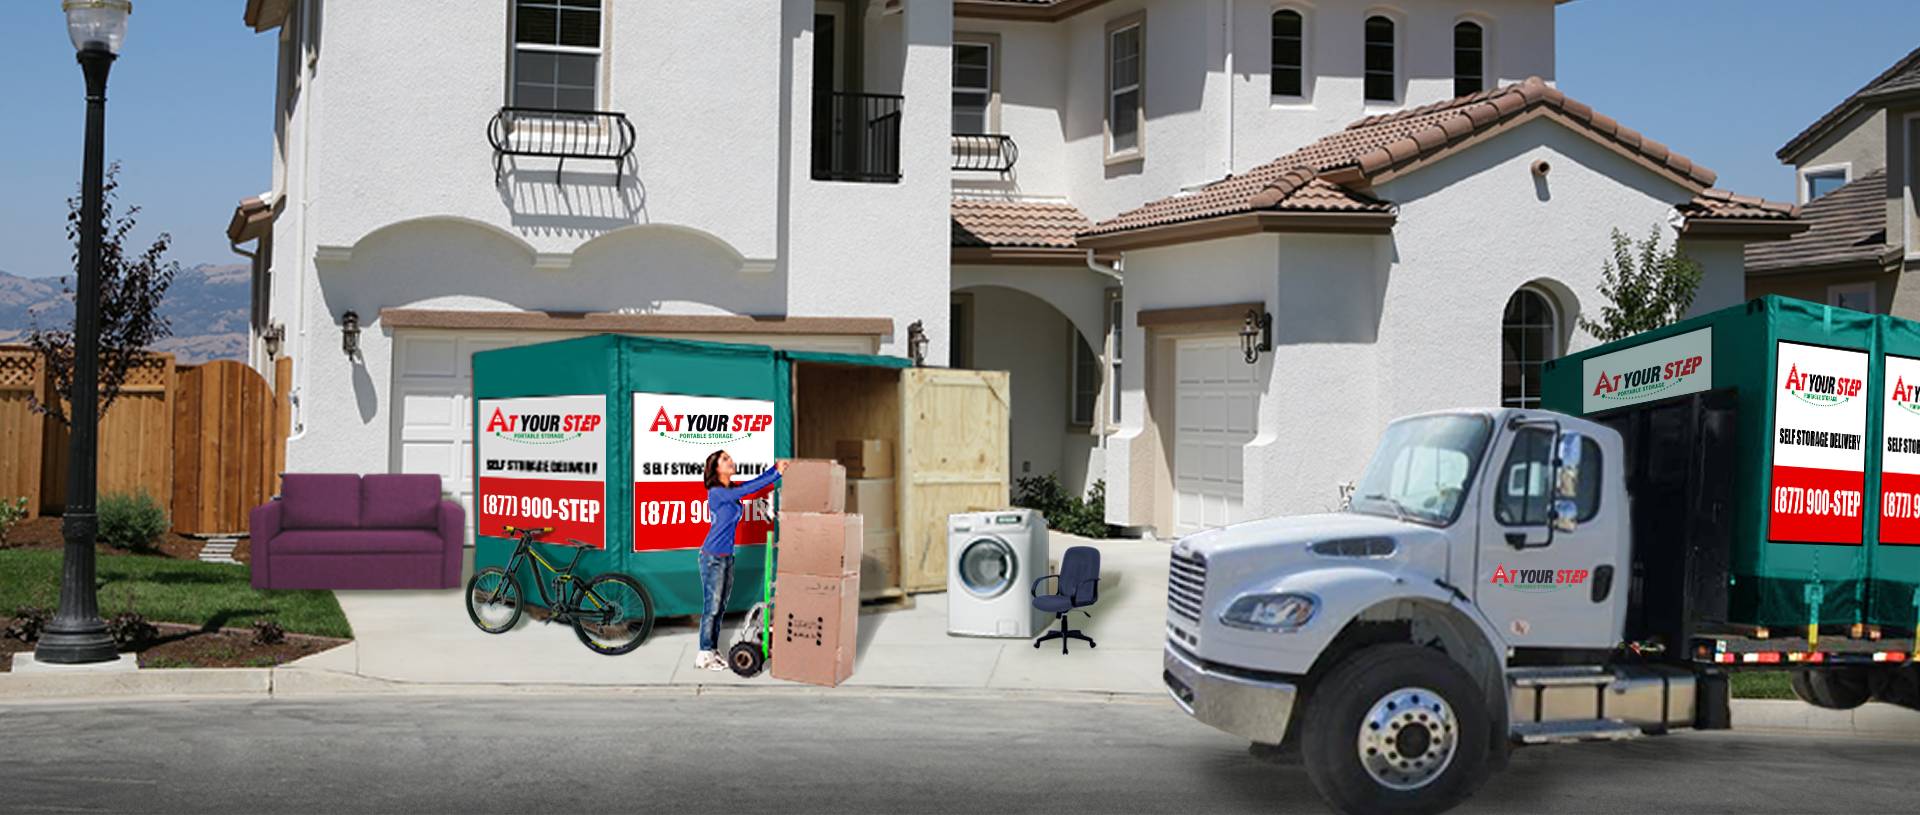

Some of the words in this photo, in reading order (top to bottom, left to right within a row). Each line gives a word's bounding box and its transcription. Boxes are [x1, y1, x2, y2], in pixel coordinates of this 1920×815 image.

[1593, 371, 1622, 396] AT
[1624, 365, 1662, 389] YOUR
[1664, 356, 1702, 380] STEP
[1785, 363, 1808, 391] AT
[1809, 374, 1836, 396] YOUR
[1837, 377, 1862, 397] STEP
[486, 406, 518, 432] AT
[521, 415, 560, 432] YOUR
[563, 414, 601, 432] STEP
[649, 405, 684, 432] AT
[687, 415, 729, 431] YOUR
[732, 414, 773, 432] STEP
[1779, 428, 1796, 445] SELF
[1797, 430, 1829, 448] STORAGE
[1830, 433, 1861, 451] DELIVERY
[1887, 437, 1903, 453] SELF
[643, 462, 670, 475] SELF
[483, 494, 518, 517] (877)
[521, 496, 600, 523] 900-STEP
[640, 500, 686, 526] (877)
[1774, 486, 1804, 515] (877)
[1806, 488, 1861, 517] 900-STEP
[1883, 491, 1912, 519] (877)
[1520, 569, 1554, 584] YOUR
[1556, 569, 1588, 584] STEP
